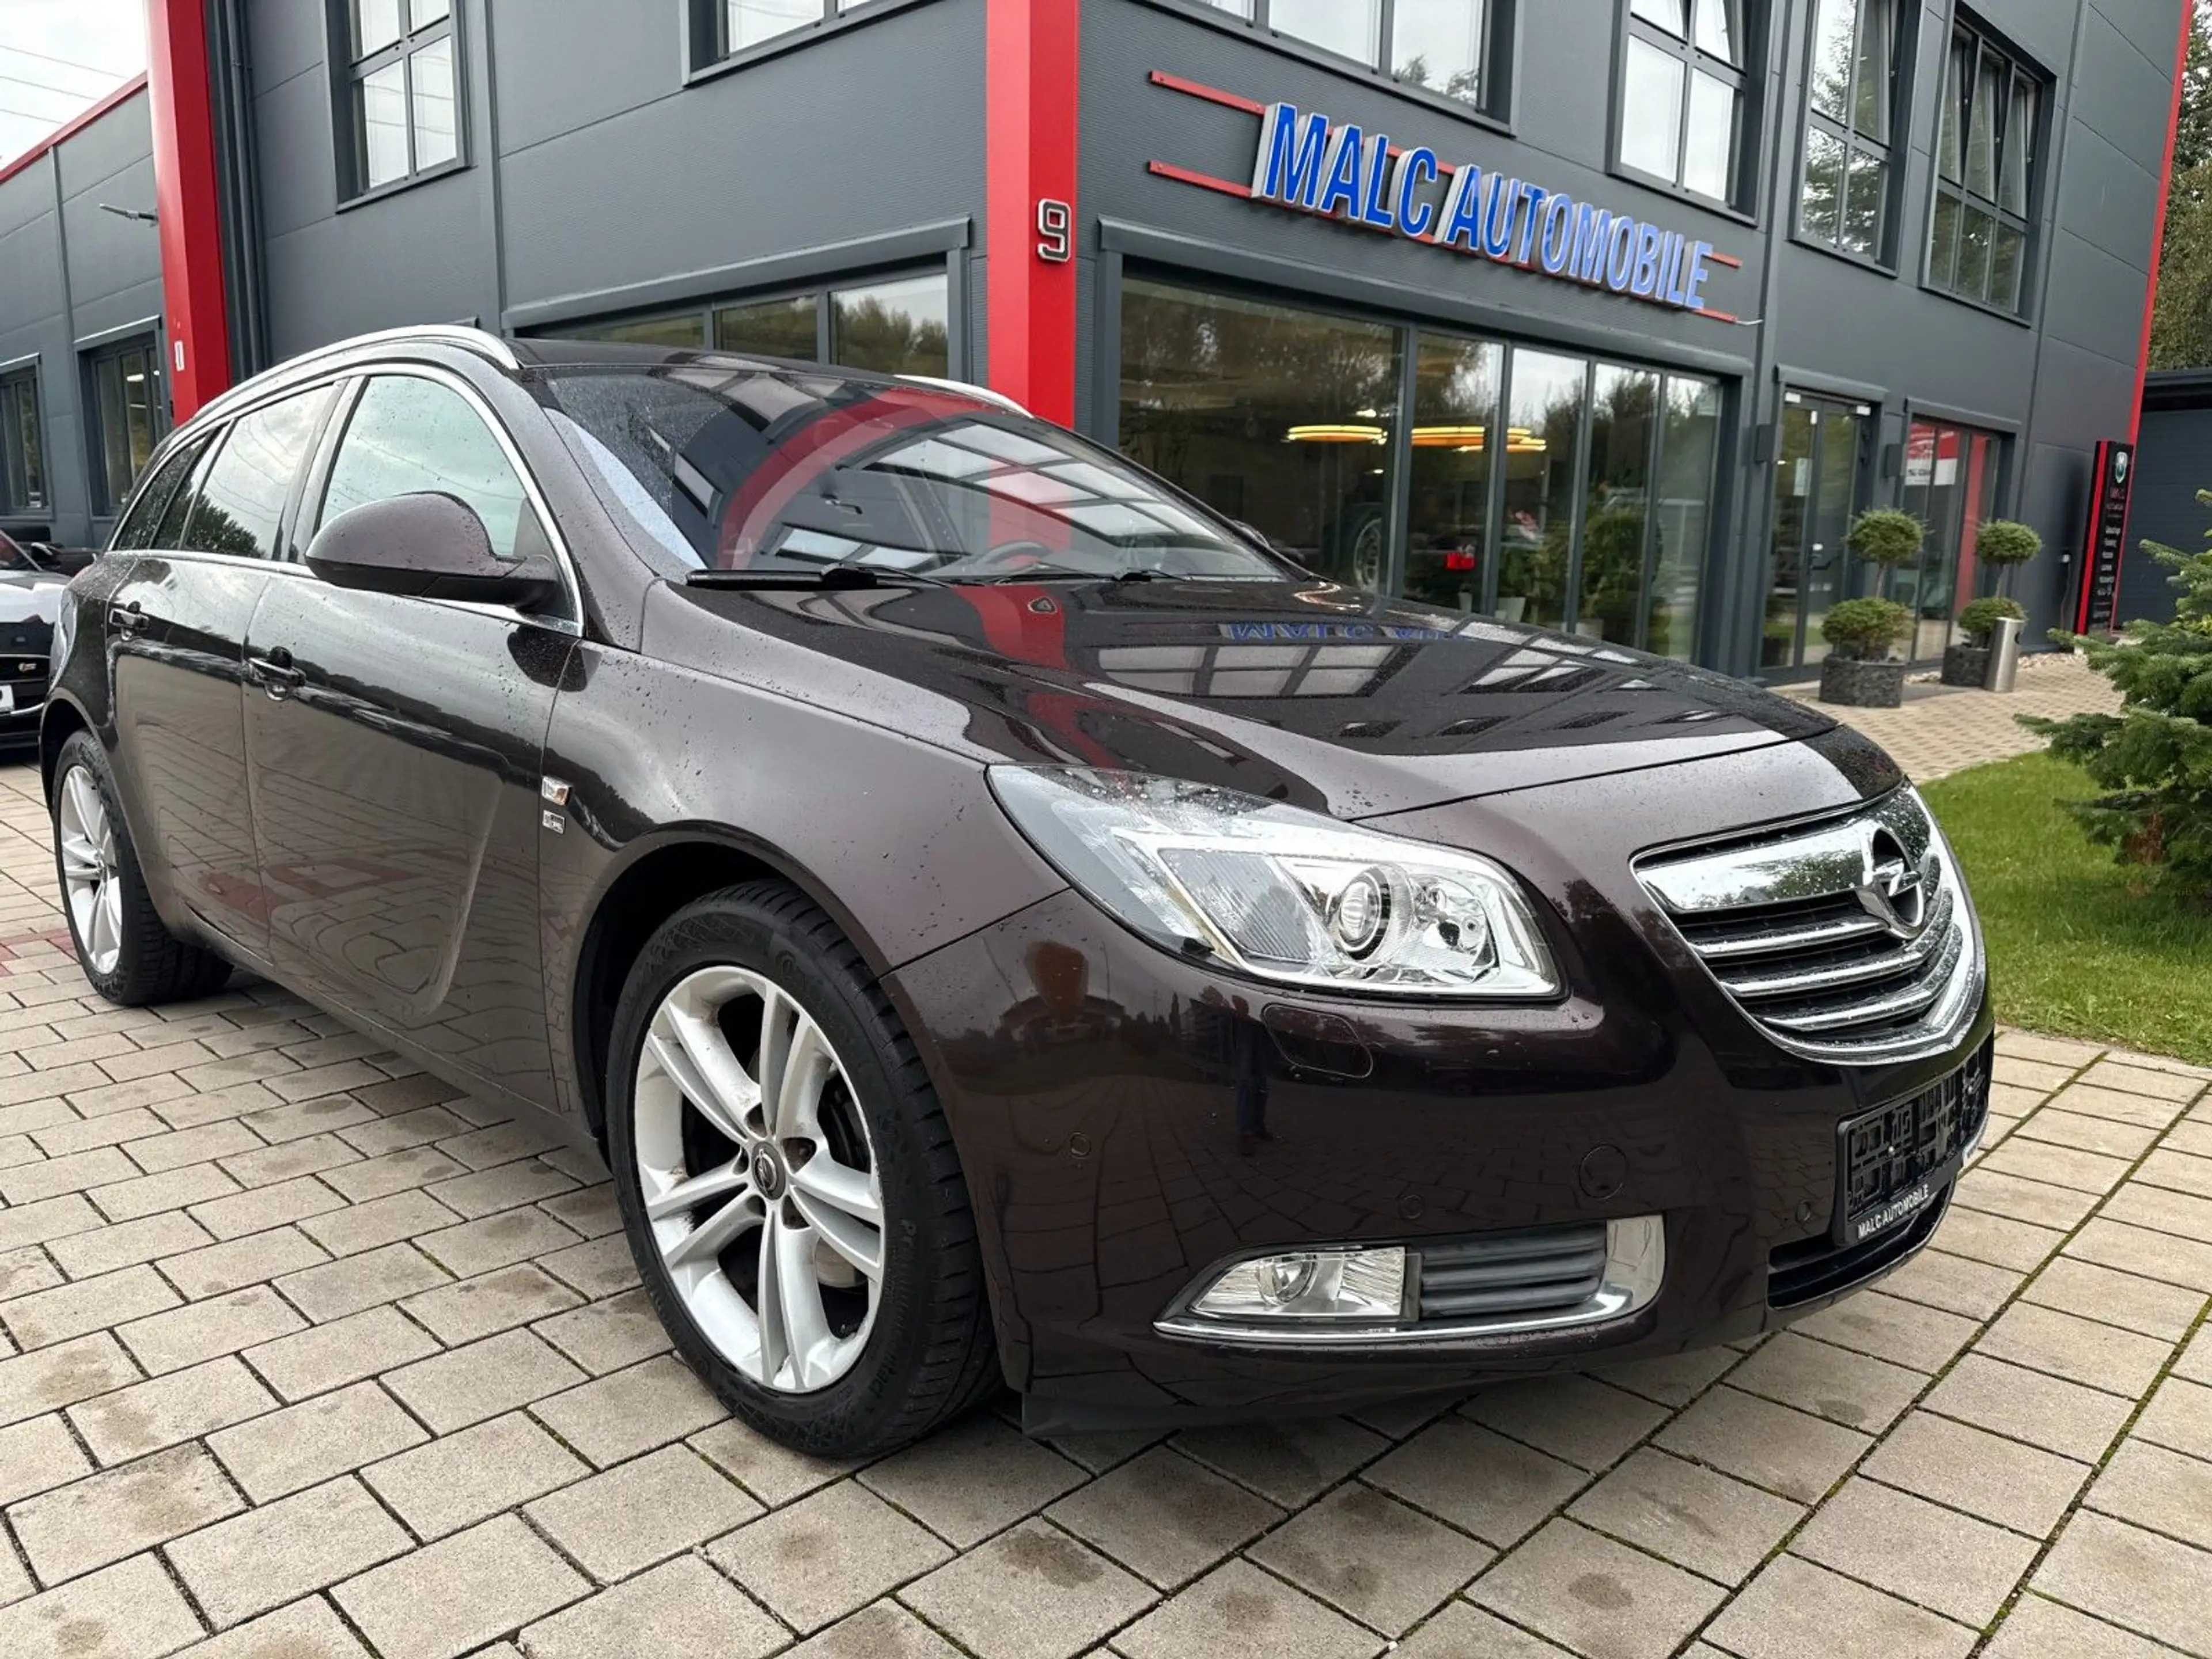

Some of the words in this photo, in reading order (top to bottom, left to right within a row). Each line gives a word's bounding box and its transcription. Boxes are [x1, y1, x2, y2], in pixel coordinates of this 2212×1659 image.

[1038, 198, 1071, 262] 9
[1256, 102, 1437, 237] MALC
[1440, 164, 1713, 310] AUTOMOBILE
[1858, 1213, 1883, 1239] MALC
[1882, 1184, 1929, 1225] AUTOMOBILE
